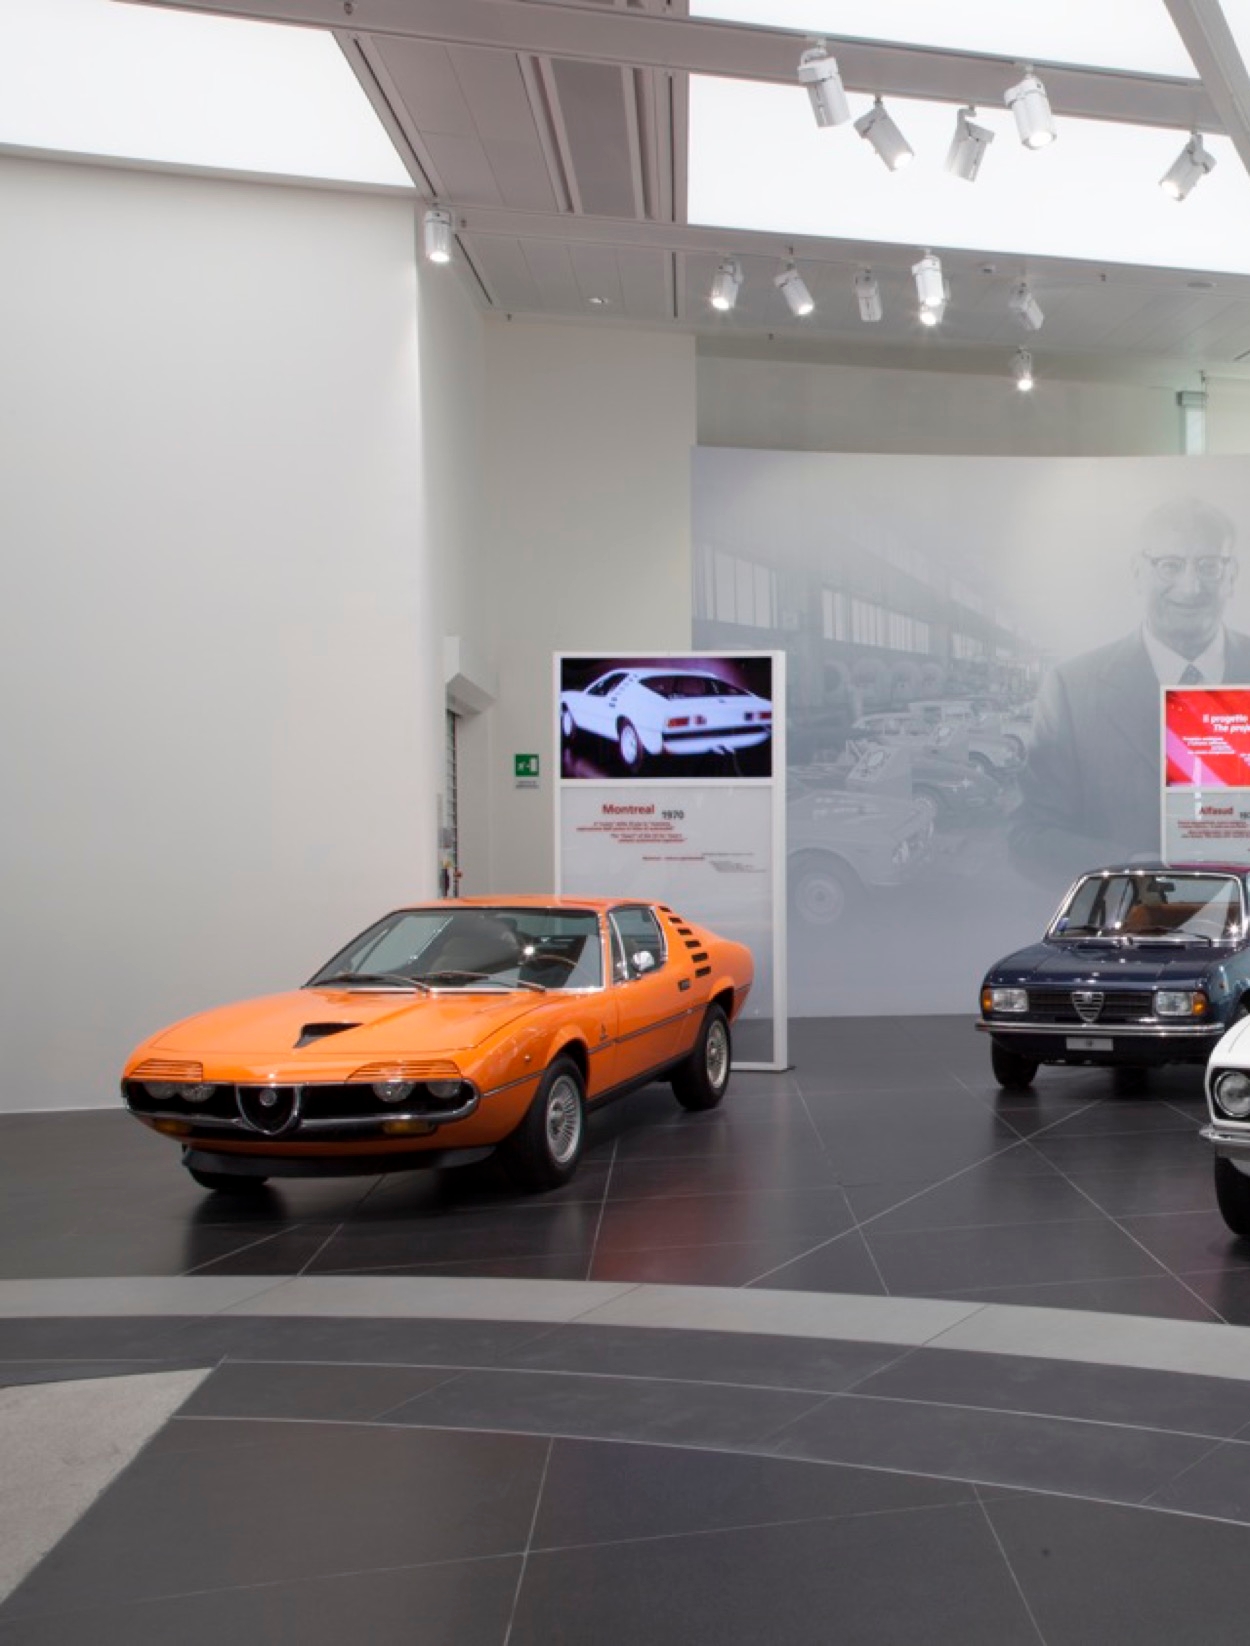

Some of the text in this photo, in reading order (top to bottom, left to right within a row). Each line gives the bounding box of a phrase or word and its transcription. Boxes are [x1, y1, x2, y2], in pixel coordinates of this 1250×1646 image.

[1214, 724, 1228, 732] The
[603, 804, 685, 820] Montreal 1970
[1200, 806, 1234, 815] Alfasud
